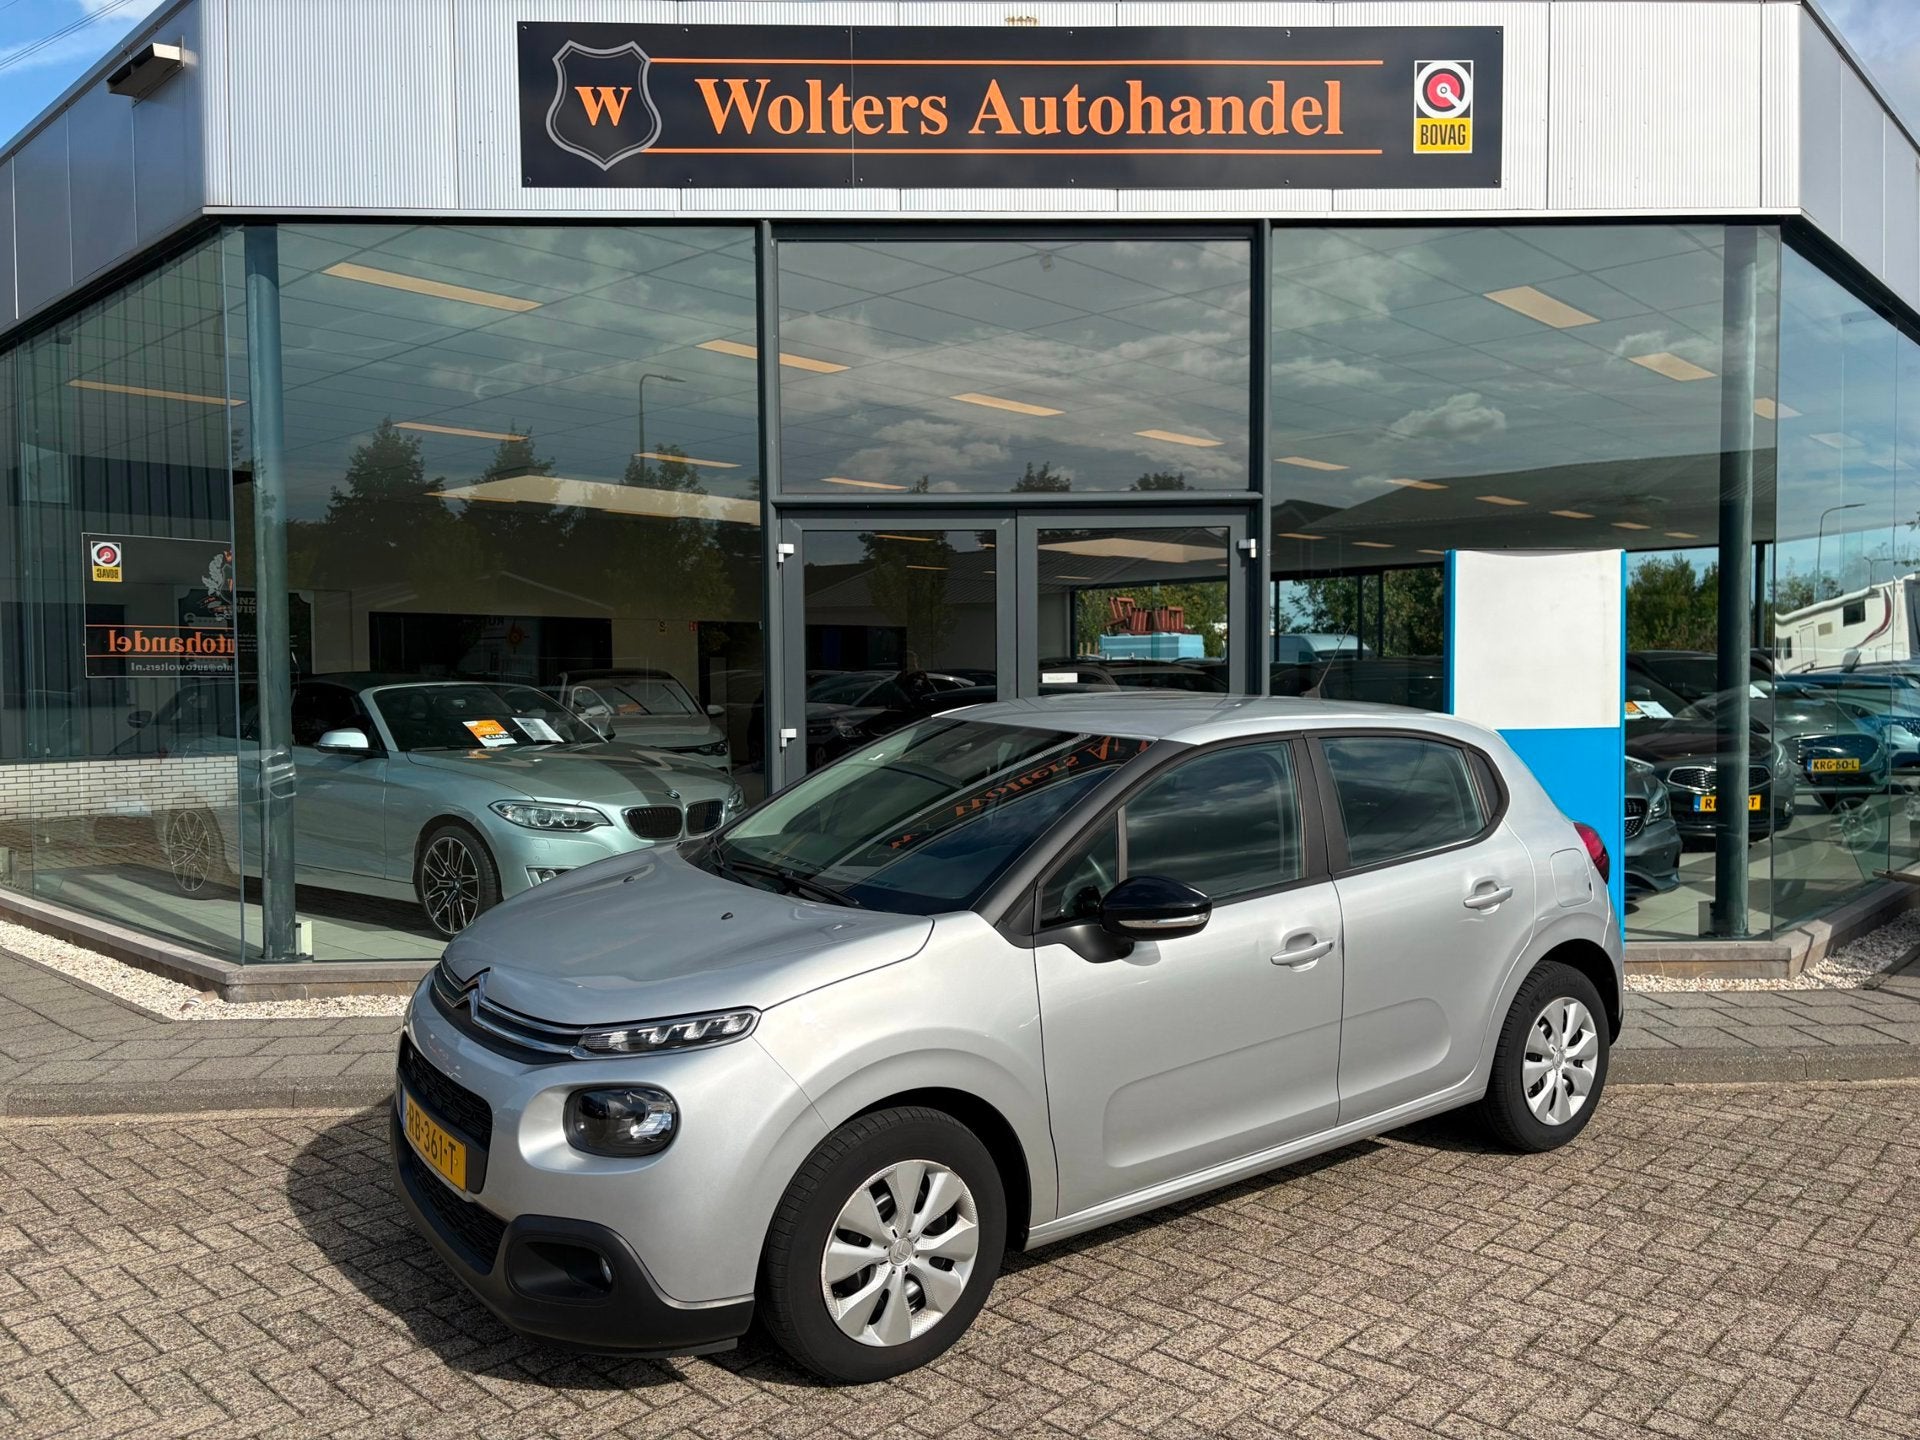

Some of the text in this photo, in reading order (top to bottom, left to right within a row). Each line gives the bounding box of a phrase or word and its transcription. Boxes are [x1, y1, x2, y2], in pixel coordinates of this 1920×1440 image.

[574, 86, 633, 127] W
[694, 78, 1345, 136] Wolters Autohandel
[1419, 118, 1467, 146] BOVAG
[408, 1102, 457, 1176] RB-361-T
